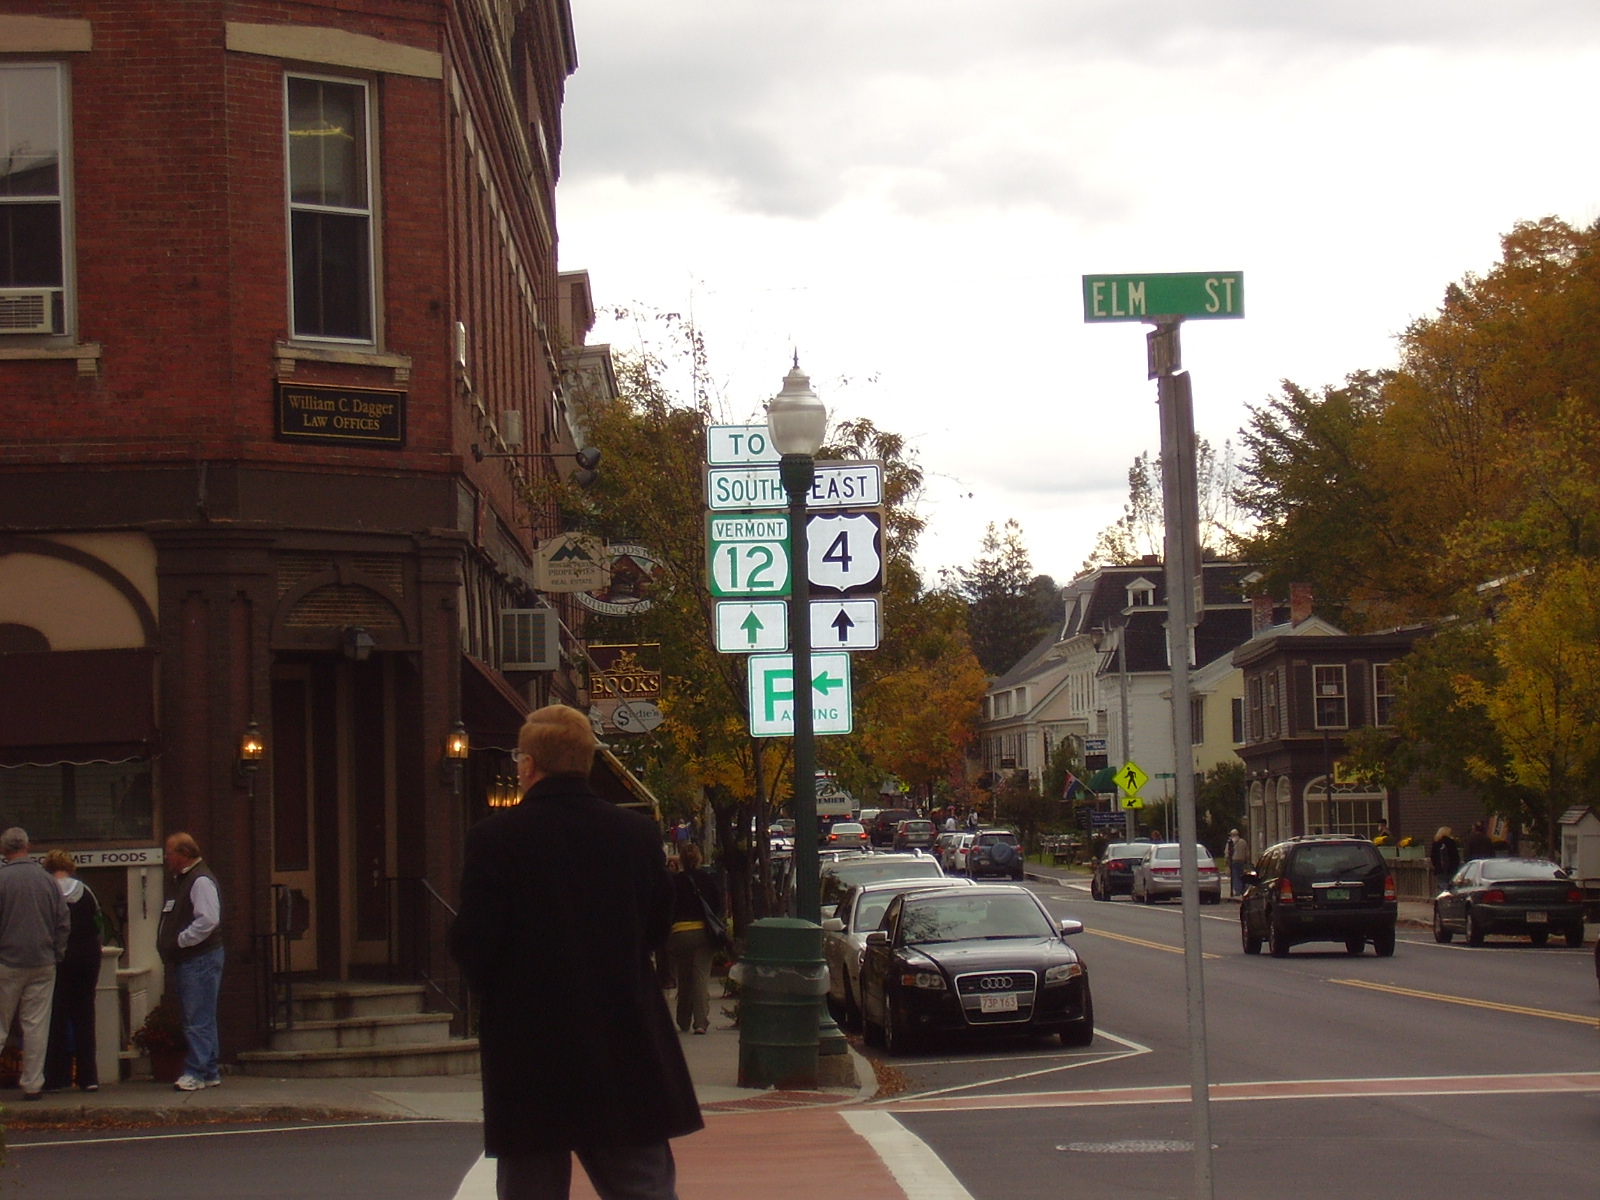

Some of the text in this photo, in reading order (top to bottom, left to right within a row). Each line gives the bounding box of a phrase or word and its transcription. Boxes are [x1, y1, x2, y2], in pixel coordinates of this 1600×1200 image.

[1092, 277, 1236, 317] ELM ST
[288, 395, 394, 418] William C. Dagger
[303, 413, 380, 431] LAW OFFICES
[728, 433, 766, 456] TO
[716, 476, 782, 502] SOUTH
[812, 475, 868, 500] EAST
[715, 522, 784, 538] VERMONT
[821, 530, 853, 573] 4
[725, 545, 775, 589] 12
[591, 675, 660, 694] BOOKS
[763, 668, 839, 722] PAING
[30, 852, 147, 865] GOMET FOODS
